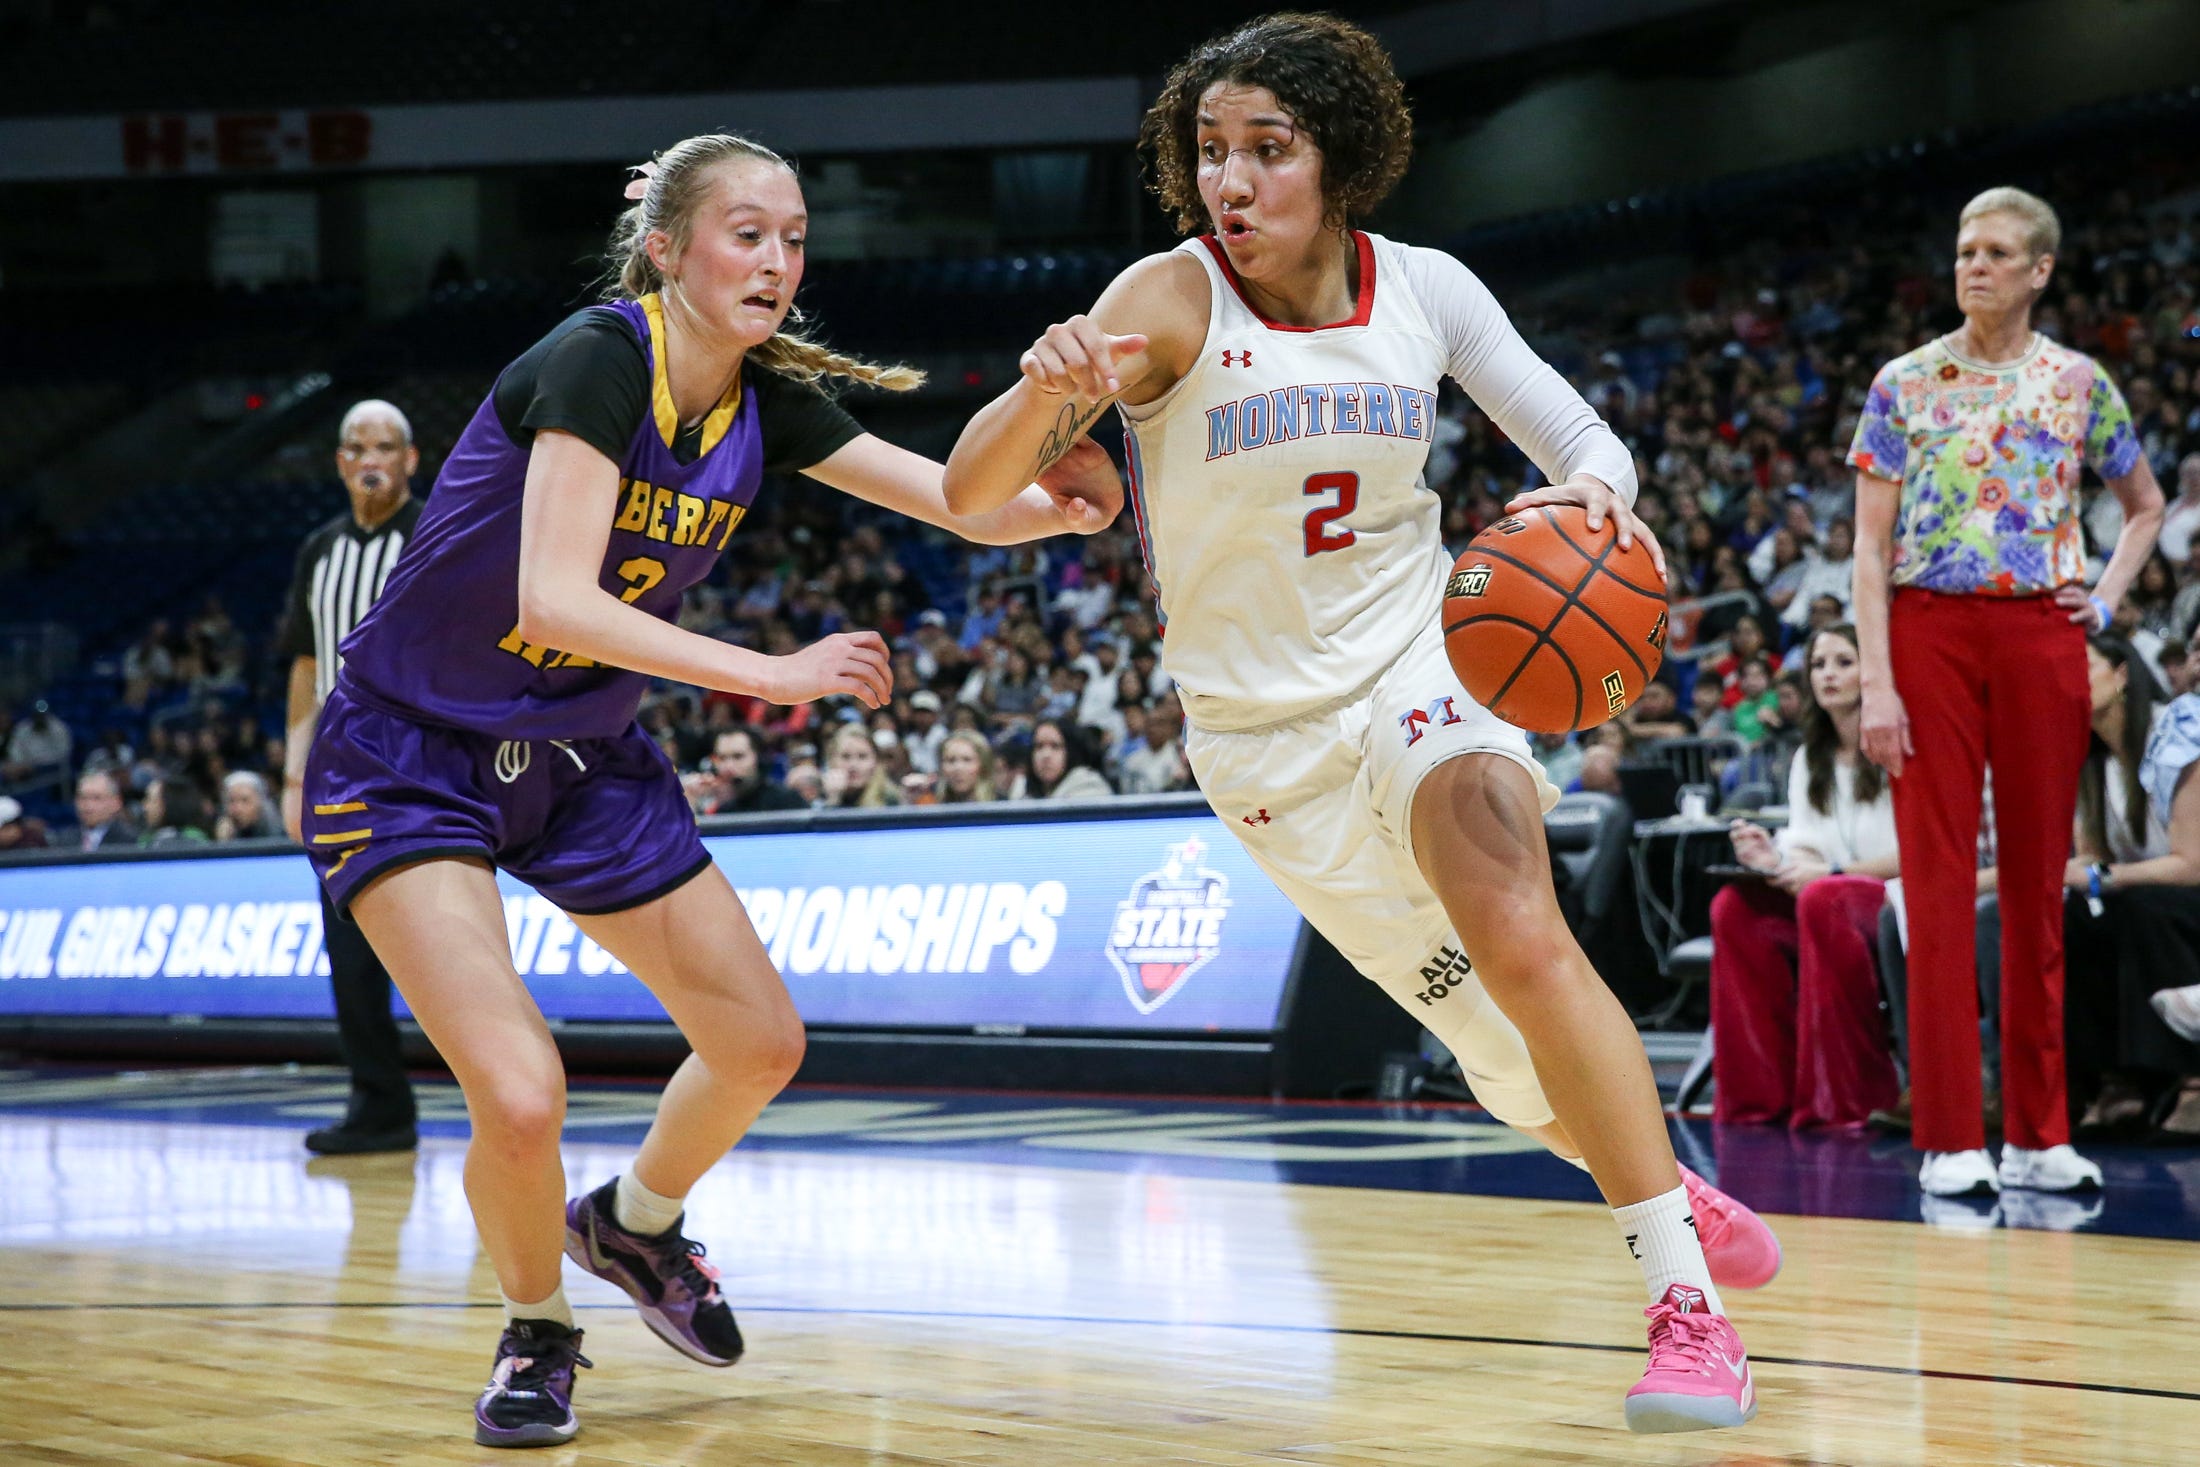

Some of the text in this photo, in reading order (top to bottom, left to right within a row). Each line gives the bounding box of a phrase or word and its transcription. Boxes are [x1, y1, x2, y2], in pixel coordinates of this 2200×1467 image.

[614, 478, 748, 551] BERTY
[1303, 470, 1360, 558] 2
[1398, 696, 1462, 748] M
[56, 904, 177, 979] GIRLS
[162, 901, 332, 979] BASKET
[1113, 907, 1227, 948] STATE
[1414, 953, 1472, 1007] FOCU
[1419, 945, 1460, 985] ALL
